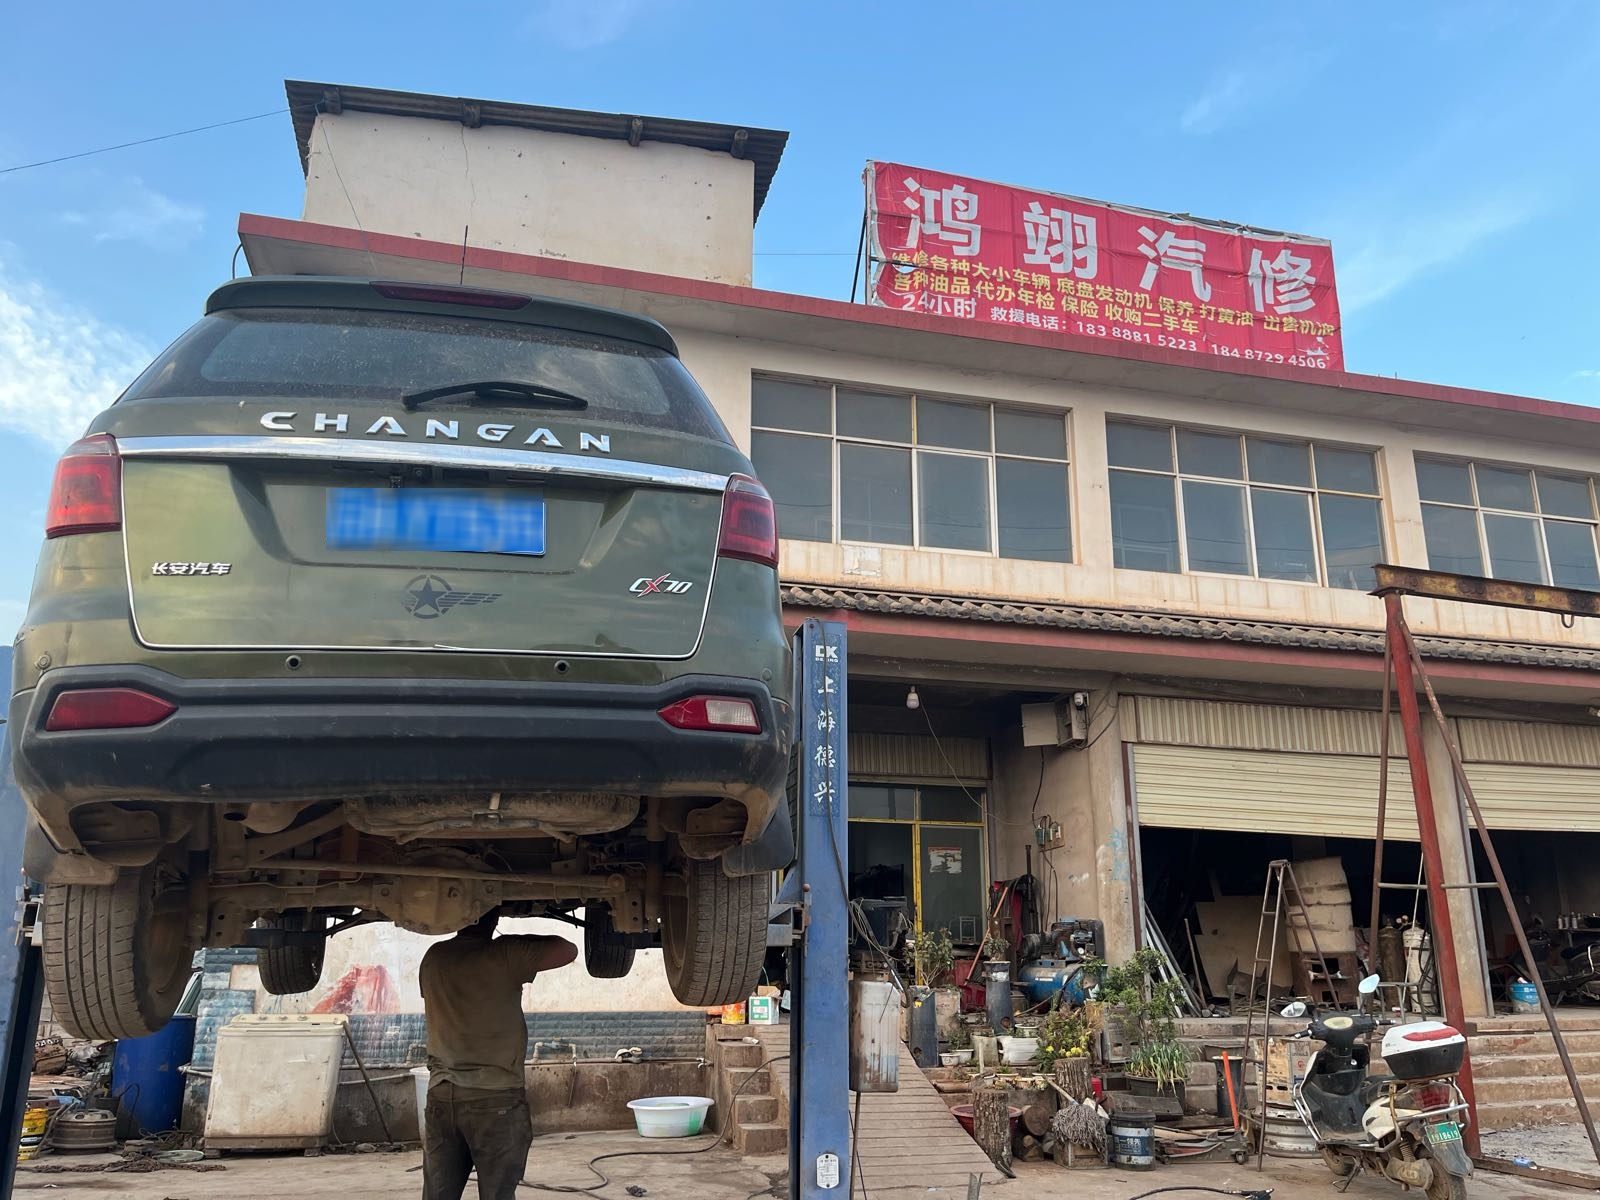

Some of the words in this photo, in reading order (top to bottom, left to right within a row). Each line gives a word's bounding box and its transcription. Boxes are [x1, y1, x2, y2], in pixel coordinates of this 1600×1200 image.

[903, 177, 1316, 315] 鸿翊汽修
[894, 270, 971, 295] 各种油品
[975, 280, 1056, 311] 代办年检
[1061, 295, 1099, 319] 保险
[1105, 303, 1199, 335] 收购二手车
[902, 291, 977, 319] 24小时
[1076, 321, 1107, 337] 183
[1112, 327, 1151, 344] 8881
[1158, 335, 1197, 351] 5223
[1211, 344, 1240, 359] 184
[1245, 349, 1284, 364] 8729
[1288, 355, 1326, 369] 4506
[1057, 277, 1152, 310] 底盘发动机
[1159, 296, 1194, 317] 保养
[1199, 304, 1254, 327] 打黄油
[260, 411, 611, 453] CHANGAN
[152, 562, 232, 576] 长安汽车
[629, 572, 693, 598] CX70
[814, 676, 836, 804] 上海德兴
